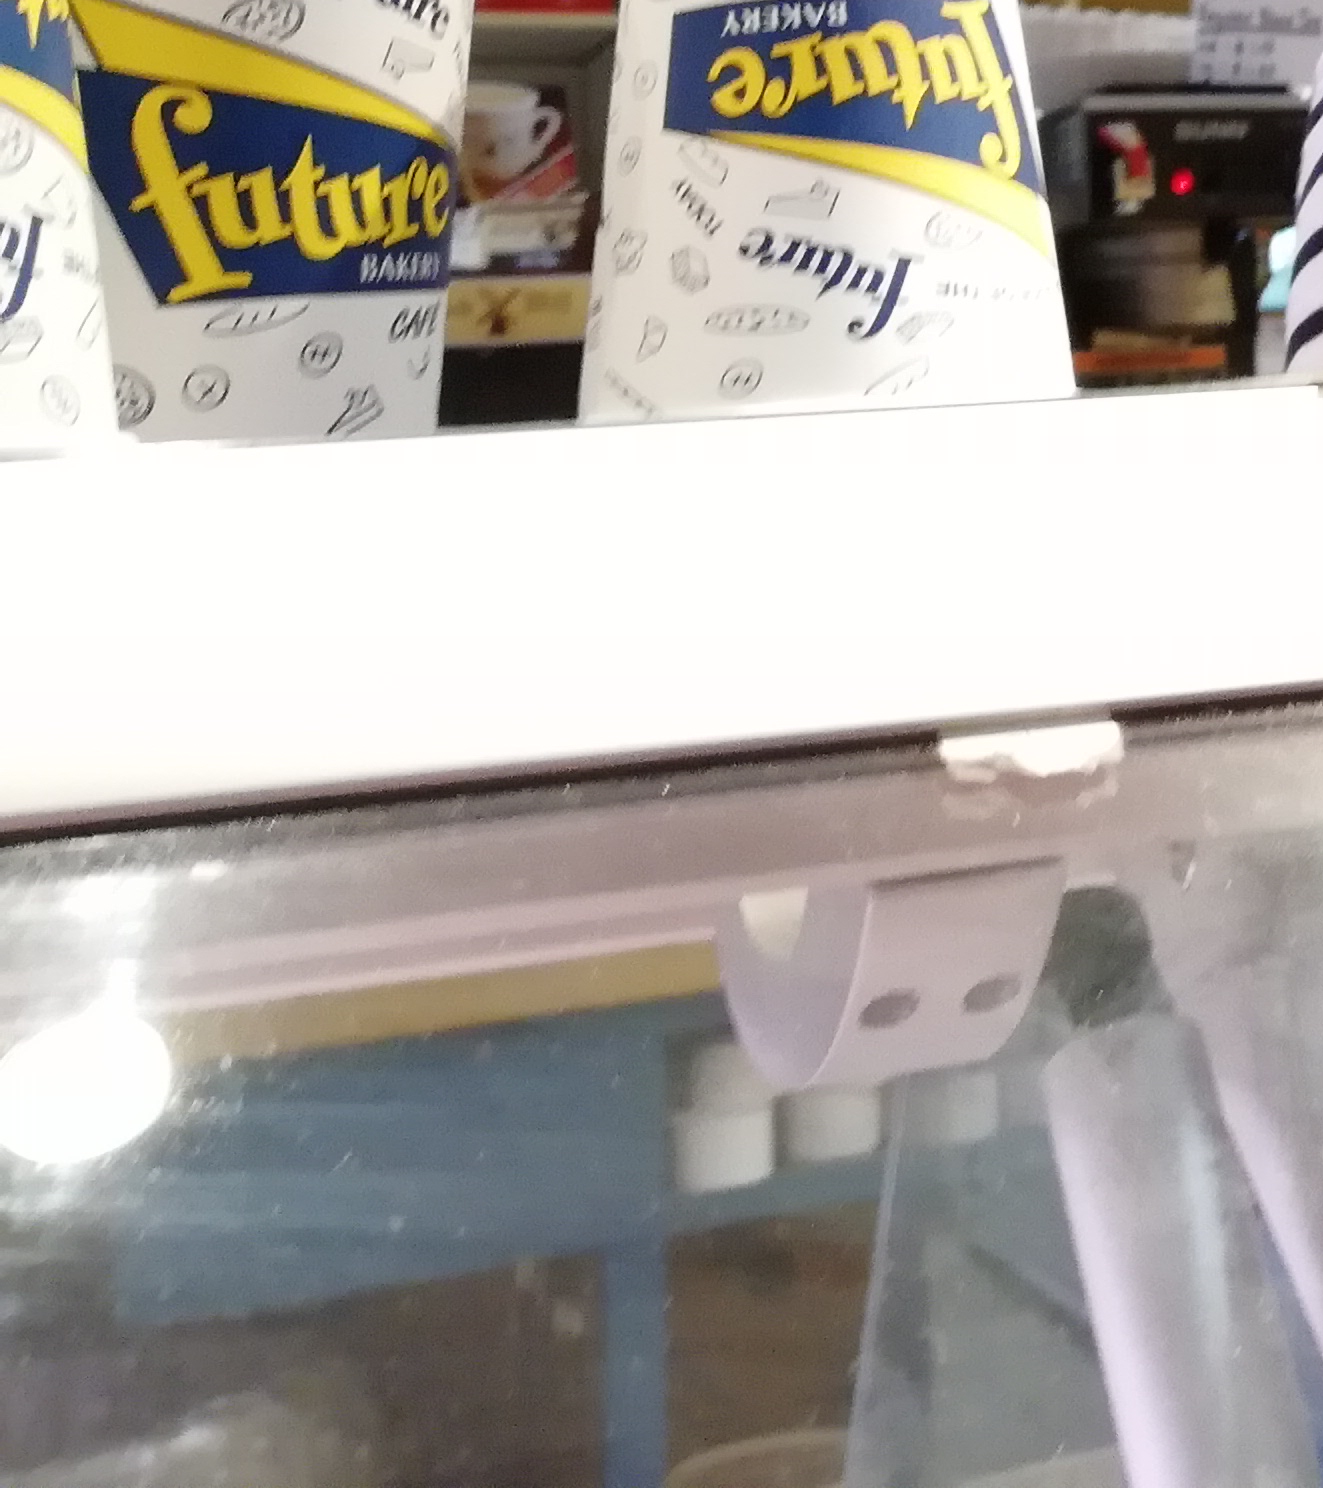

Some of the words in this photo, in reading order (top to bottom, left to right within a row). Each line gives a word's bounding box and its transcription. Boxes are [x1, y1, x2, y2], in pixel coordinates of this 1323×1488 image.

[706, 0, 1021, 180] future
[128, 82, 450, 303] future
[738, 226, 924, 341] future
